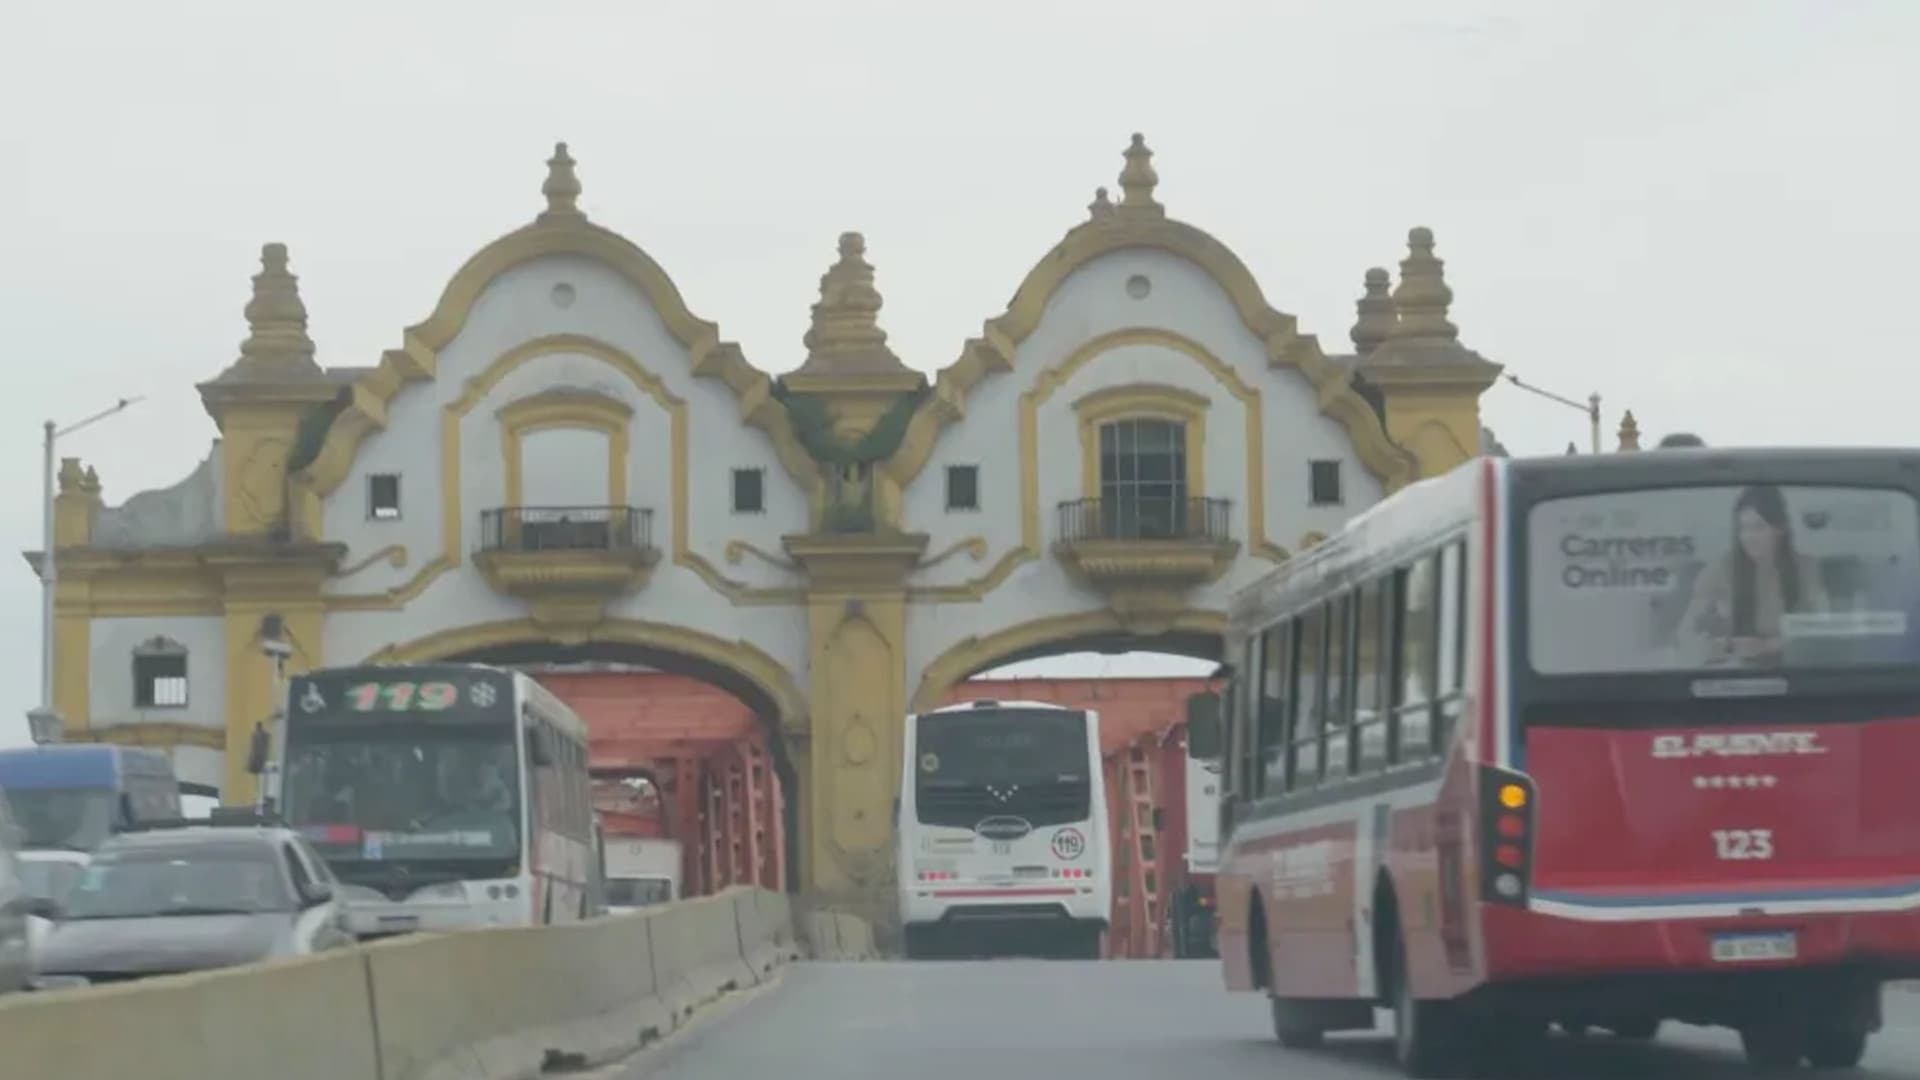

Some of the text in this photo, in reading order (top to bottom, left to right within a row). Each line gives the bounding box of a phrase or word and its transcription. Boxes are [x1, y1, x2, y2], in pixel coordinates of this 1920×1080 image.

[1560, 534, 1695, 557] Carreras
[1562, 564, 1670, 588] Online
[345, 681, 457, 711] 119
[1057, 836, 1079, 853] 119
[1712, 829, 1773, 860] 123
